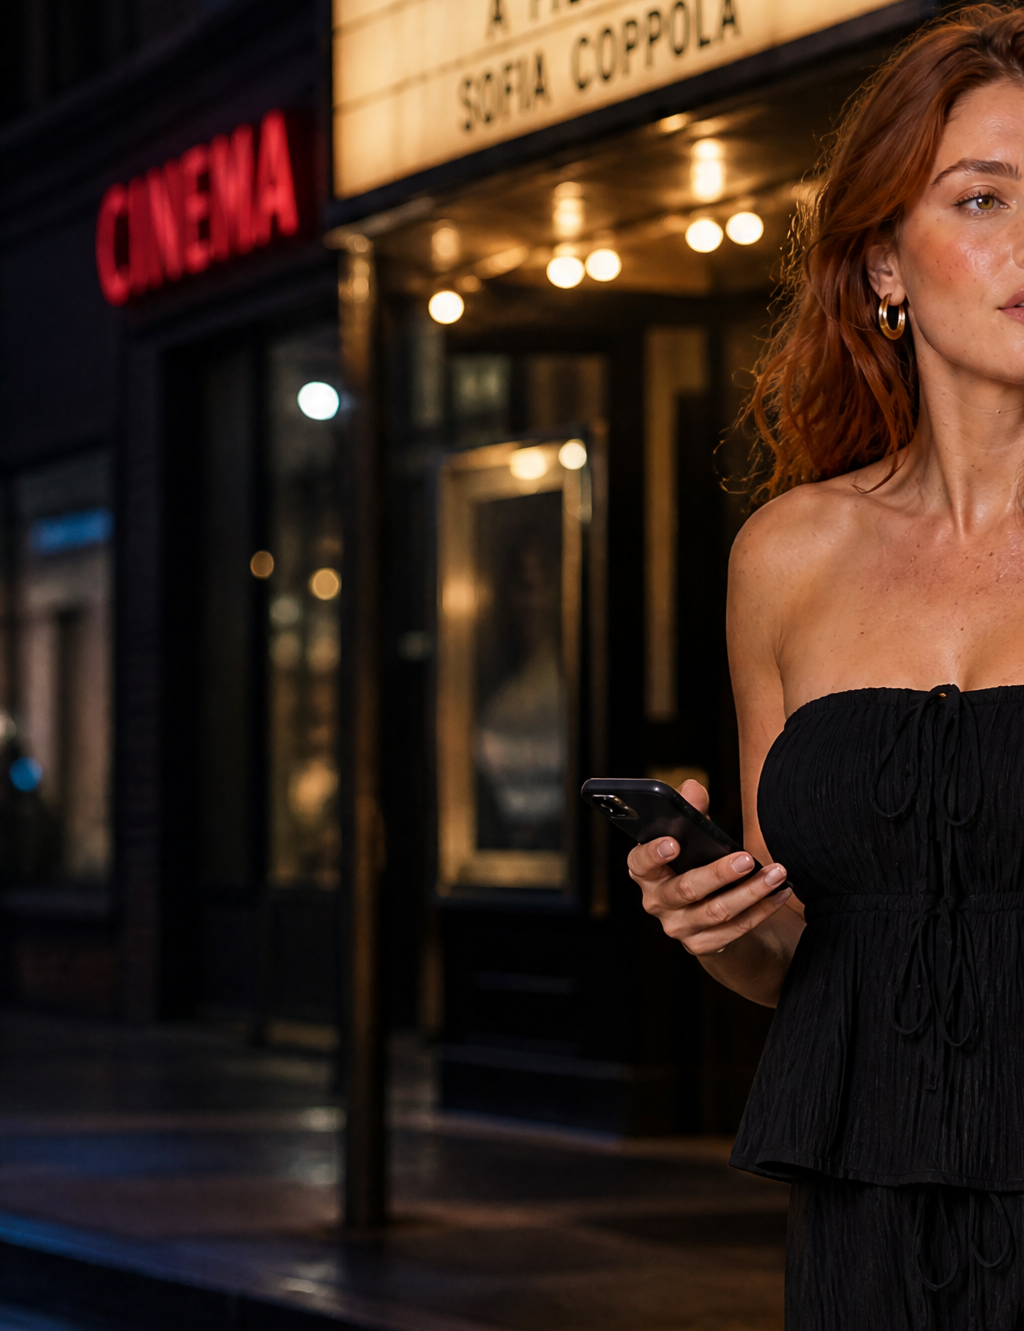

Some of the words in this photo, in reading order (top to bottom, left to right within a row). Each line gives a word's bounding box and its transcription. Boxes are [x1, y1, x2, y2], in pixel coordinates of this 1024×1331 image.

[458, 50, 551, 134] SOFIA
[571, 0, 740, 91] COPPOLA
[96, 108, 298, 306] CINEMA
